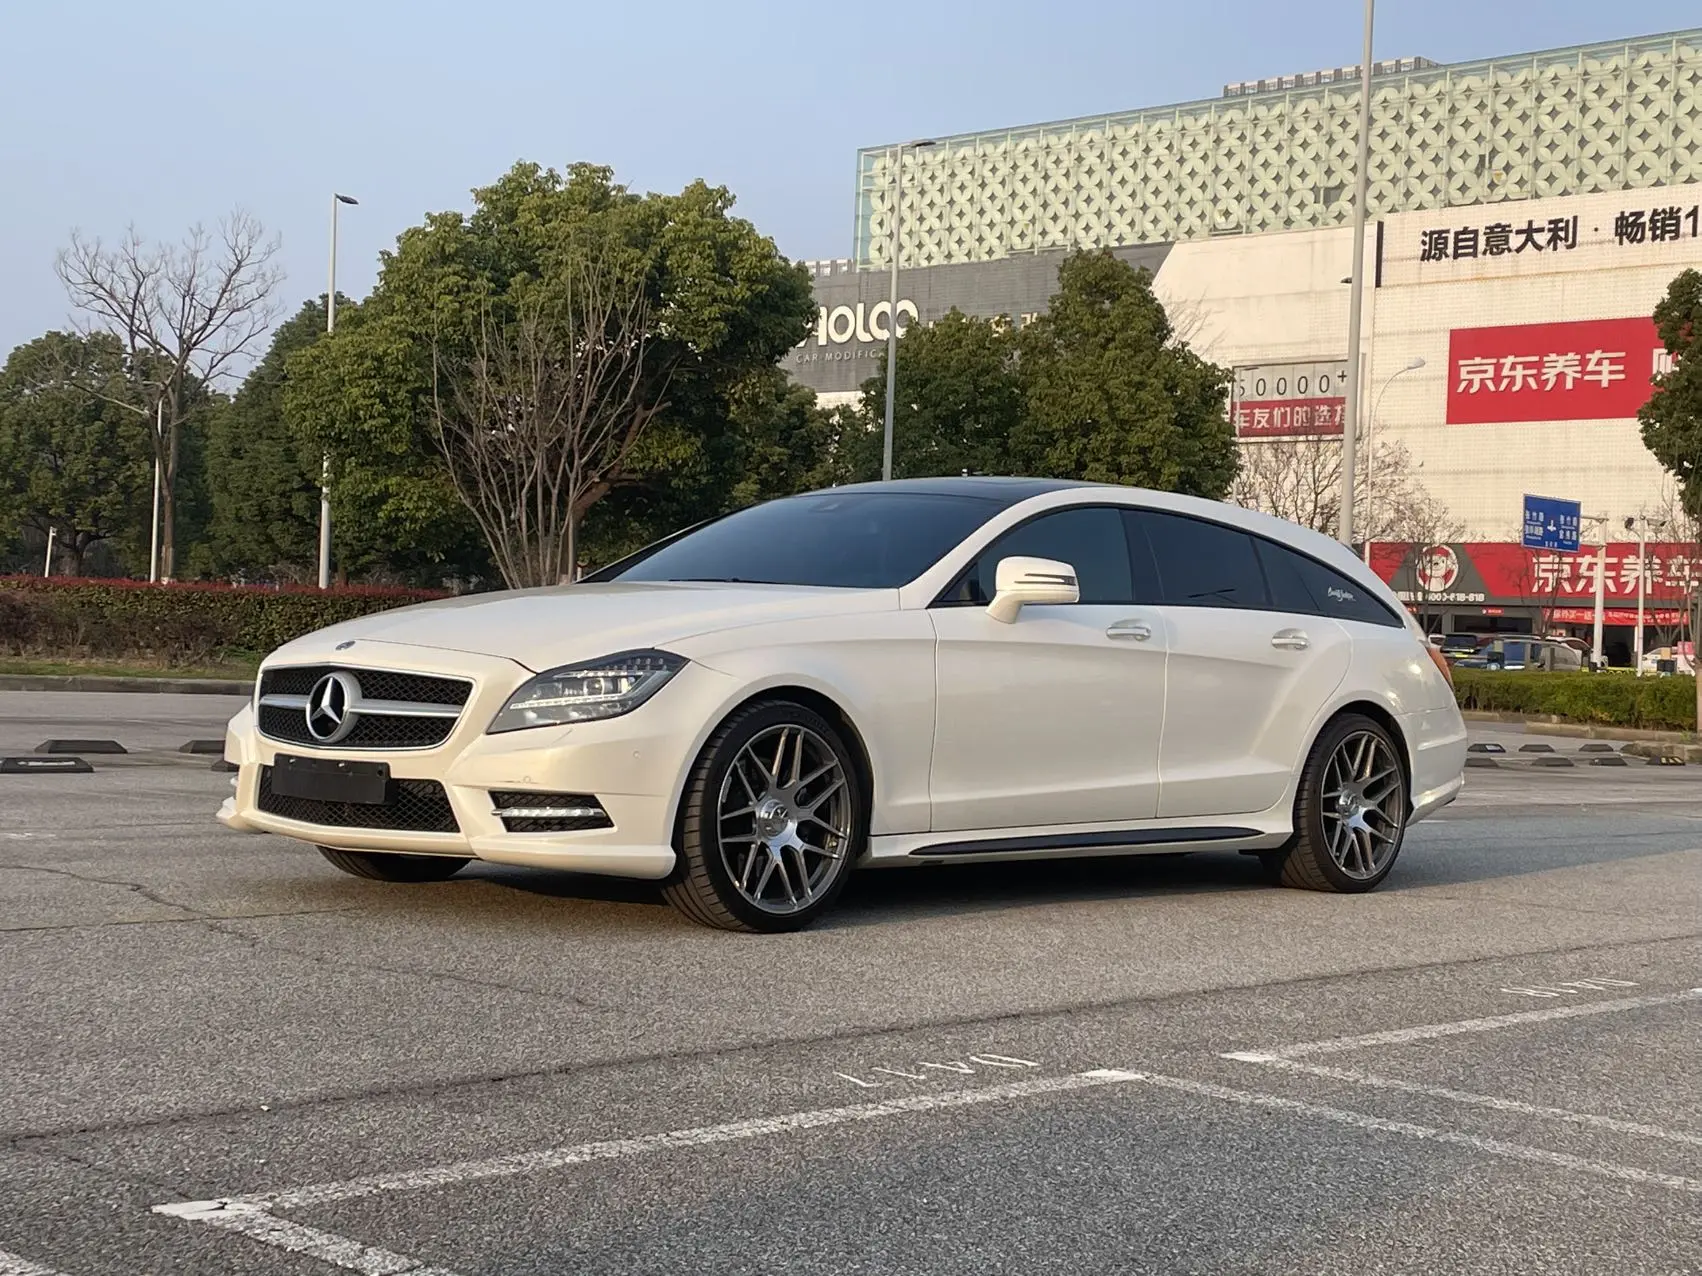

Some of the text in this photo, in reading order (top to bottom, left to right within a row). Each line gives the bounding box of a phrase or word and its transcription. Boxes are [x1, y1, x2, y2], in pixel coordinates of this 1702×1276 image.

[1420, 215, 1578, 262] 源自意大利
[796, 353, 818, 363] CAR
[1457, 350, 1626, 394] 京东养车
[1532, 555, 1700, 594] 京东养车
